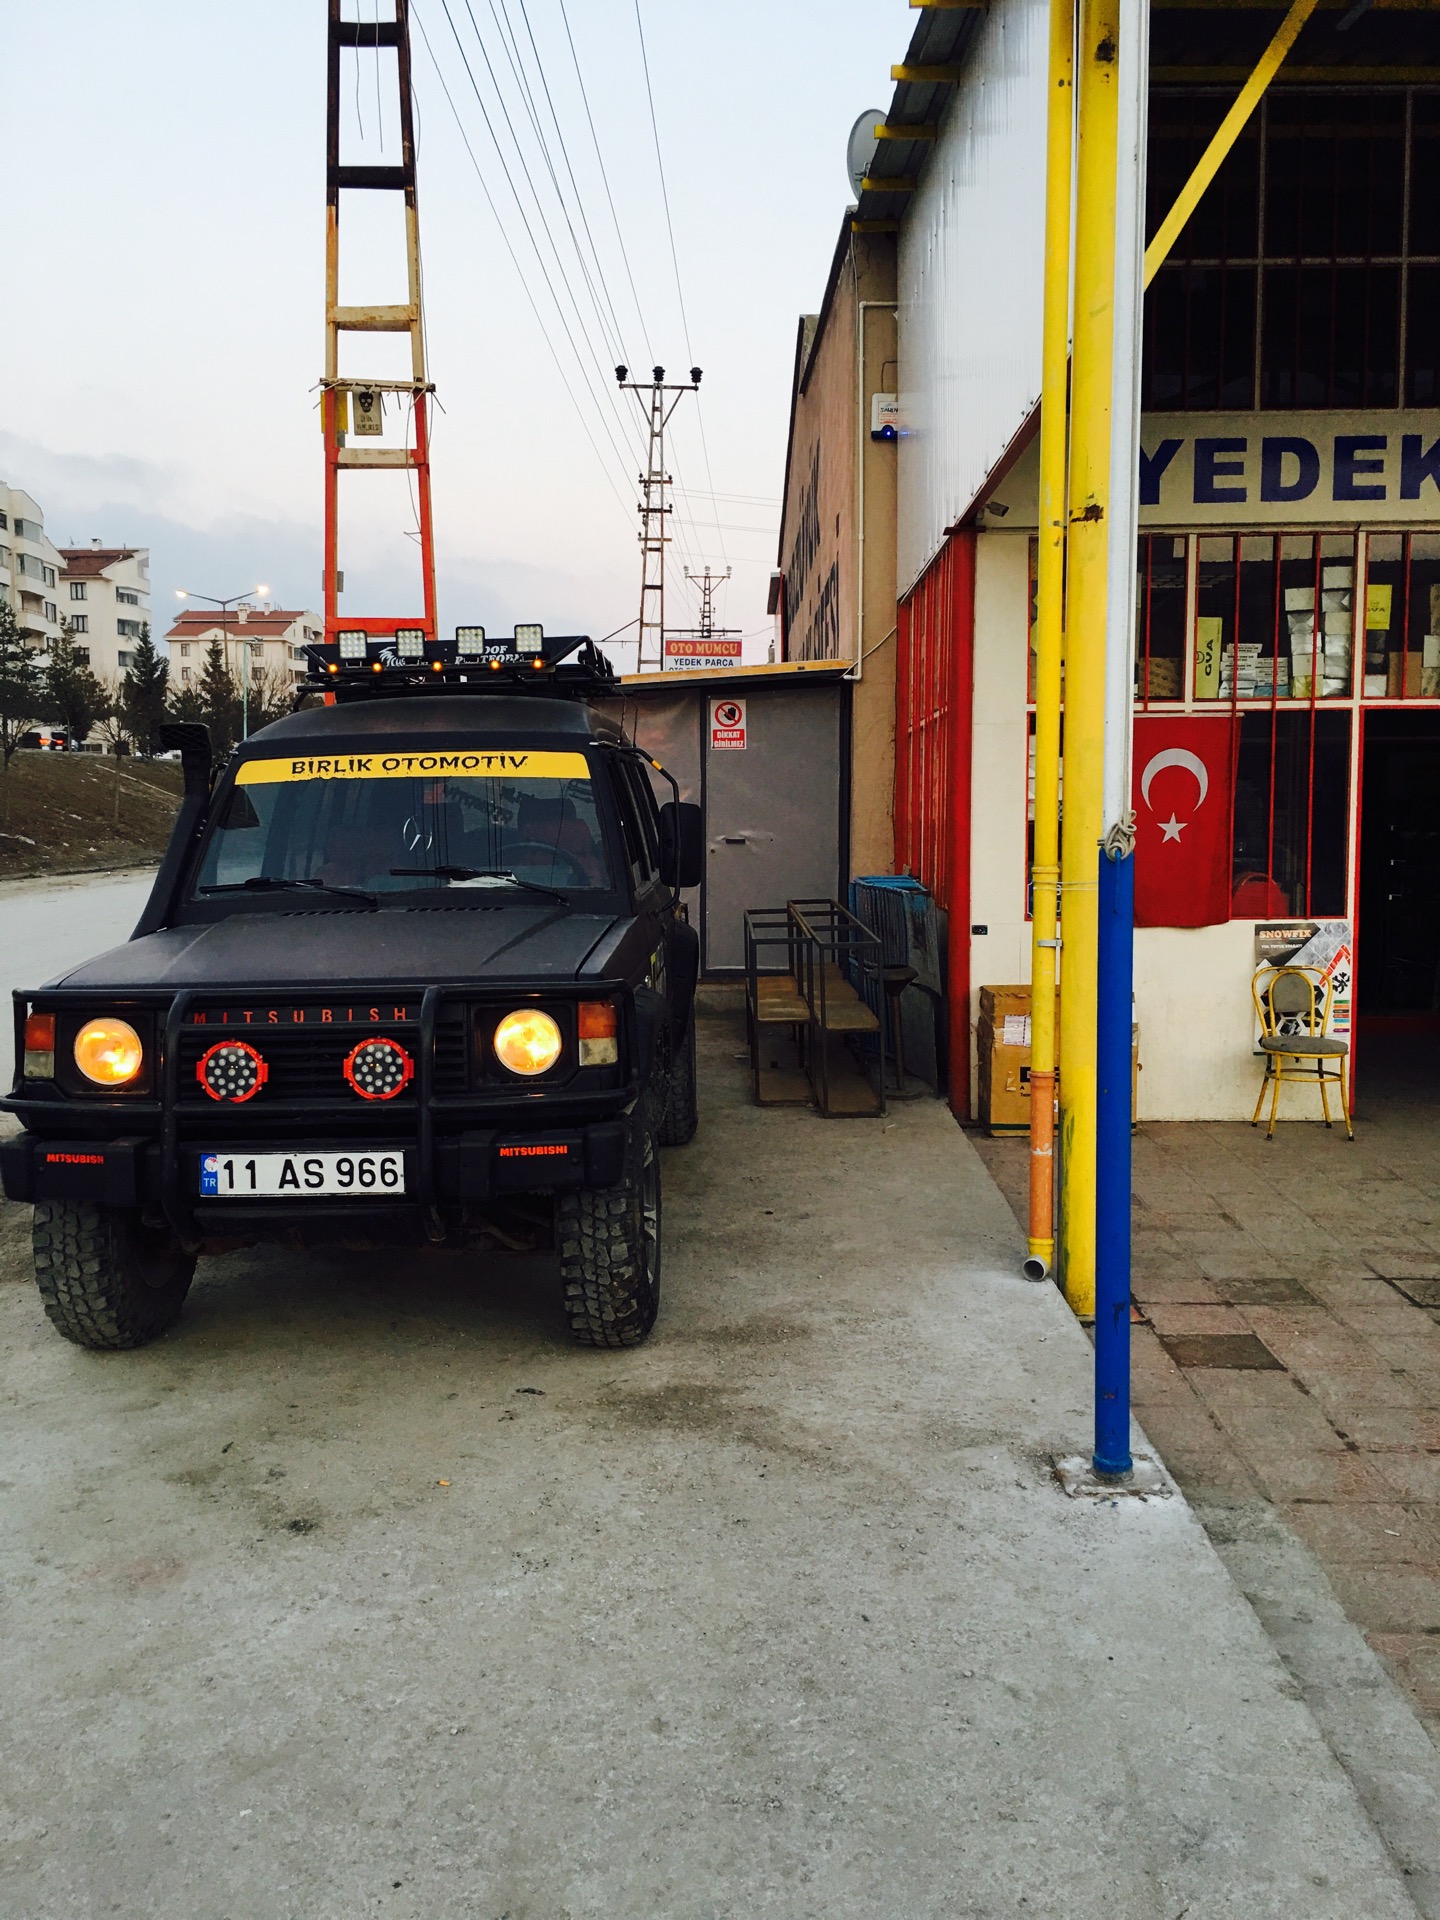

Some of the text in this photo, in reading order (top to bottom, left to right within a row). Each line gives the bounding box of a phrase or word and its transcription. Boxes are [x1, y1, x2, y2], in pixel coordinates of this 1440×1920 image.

[1139, 434, 1440, 506] YEDEK
[670, 642, 738, 655] OTO MUMCU
[673, 658, 702, 666] YEDEK
[1204, 638, 1214, 677] GVA
[716, 730, 741, 739] DİKKAT
[714, 738, 744, 748] GİRİLMEZ
[291, 752, 529, 775] BİRLİK OTOMOTİV
[1259, 929, 1312, 939] SNOWFIX
[498, 1145, 569, 1157] MITSUBISHI
[203, 1156, 400, 1190] TR 11 AS 966
